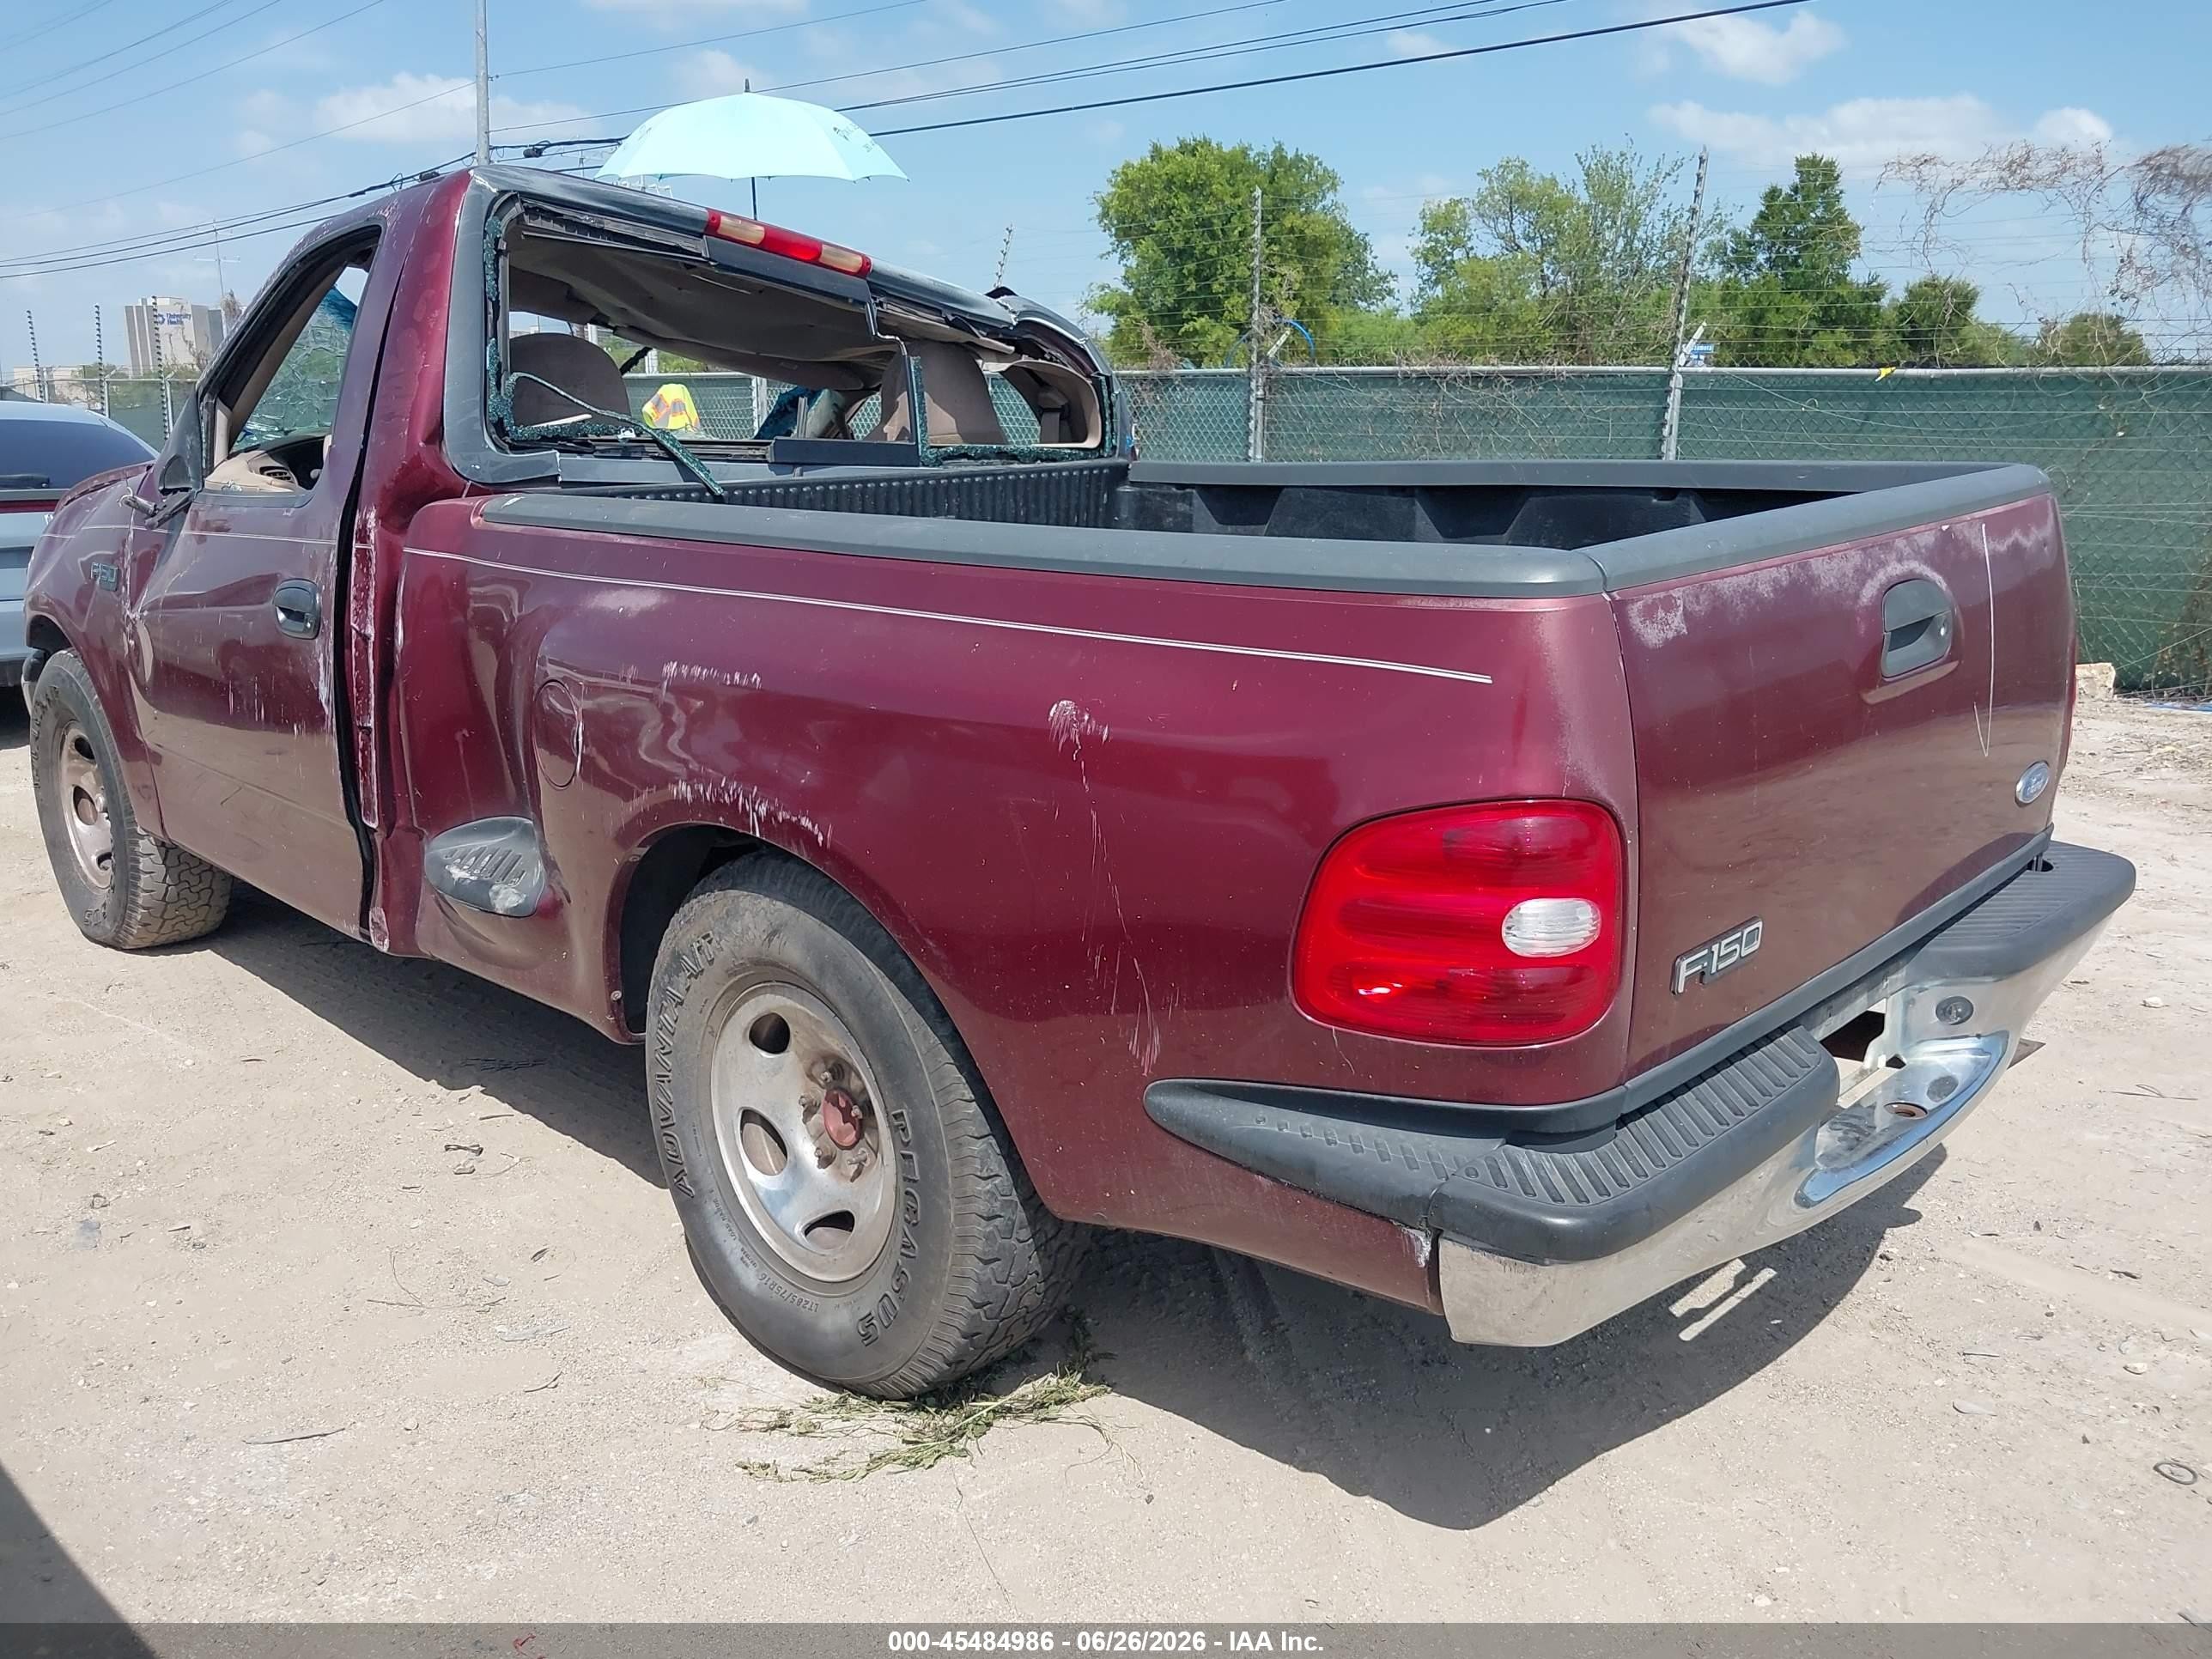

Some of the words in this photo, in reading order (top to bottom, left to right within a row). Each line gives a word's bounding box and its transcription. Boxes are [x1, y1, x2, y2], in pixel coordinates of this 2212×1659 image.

[655, 987, 696, 1199] ADVANTA
[758, 1272, 819, 1312] LT285/75R16
[857, 1108, 921, 1347] PEGASUS
